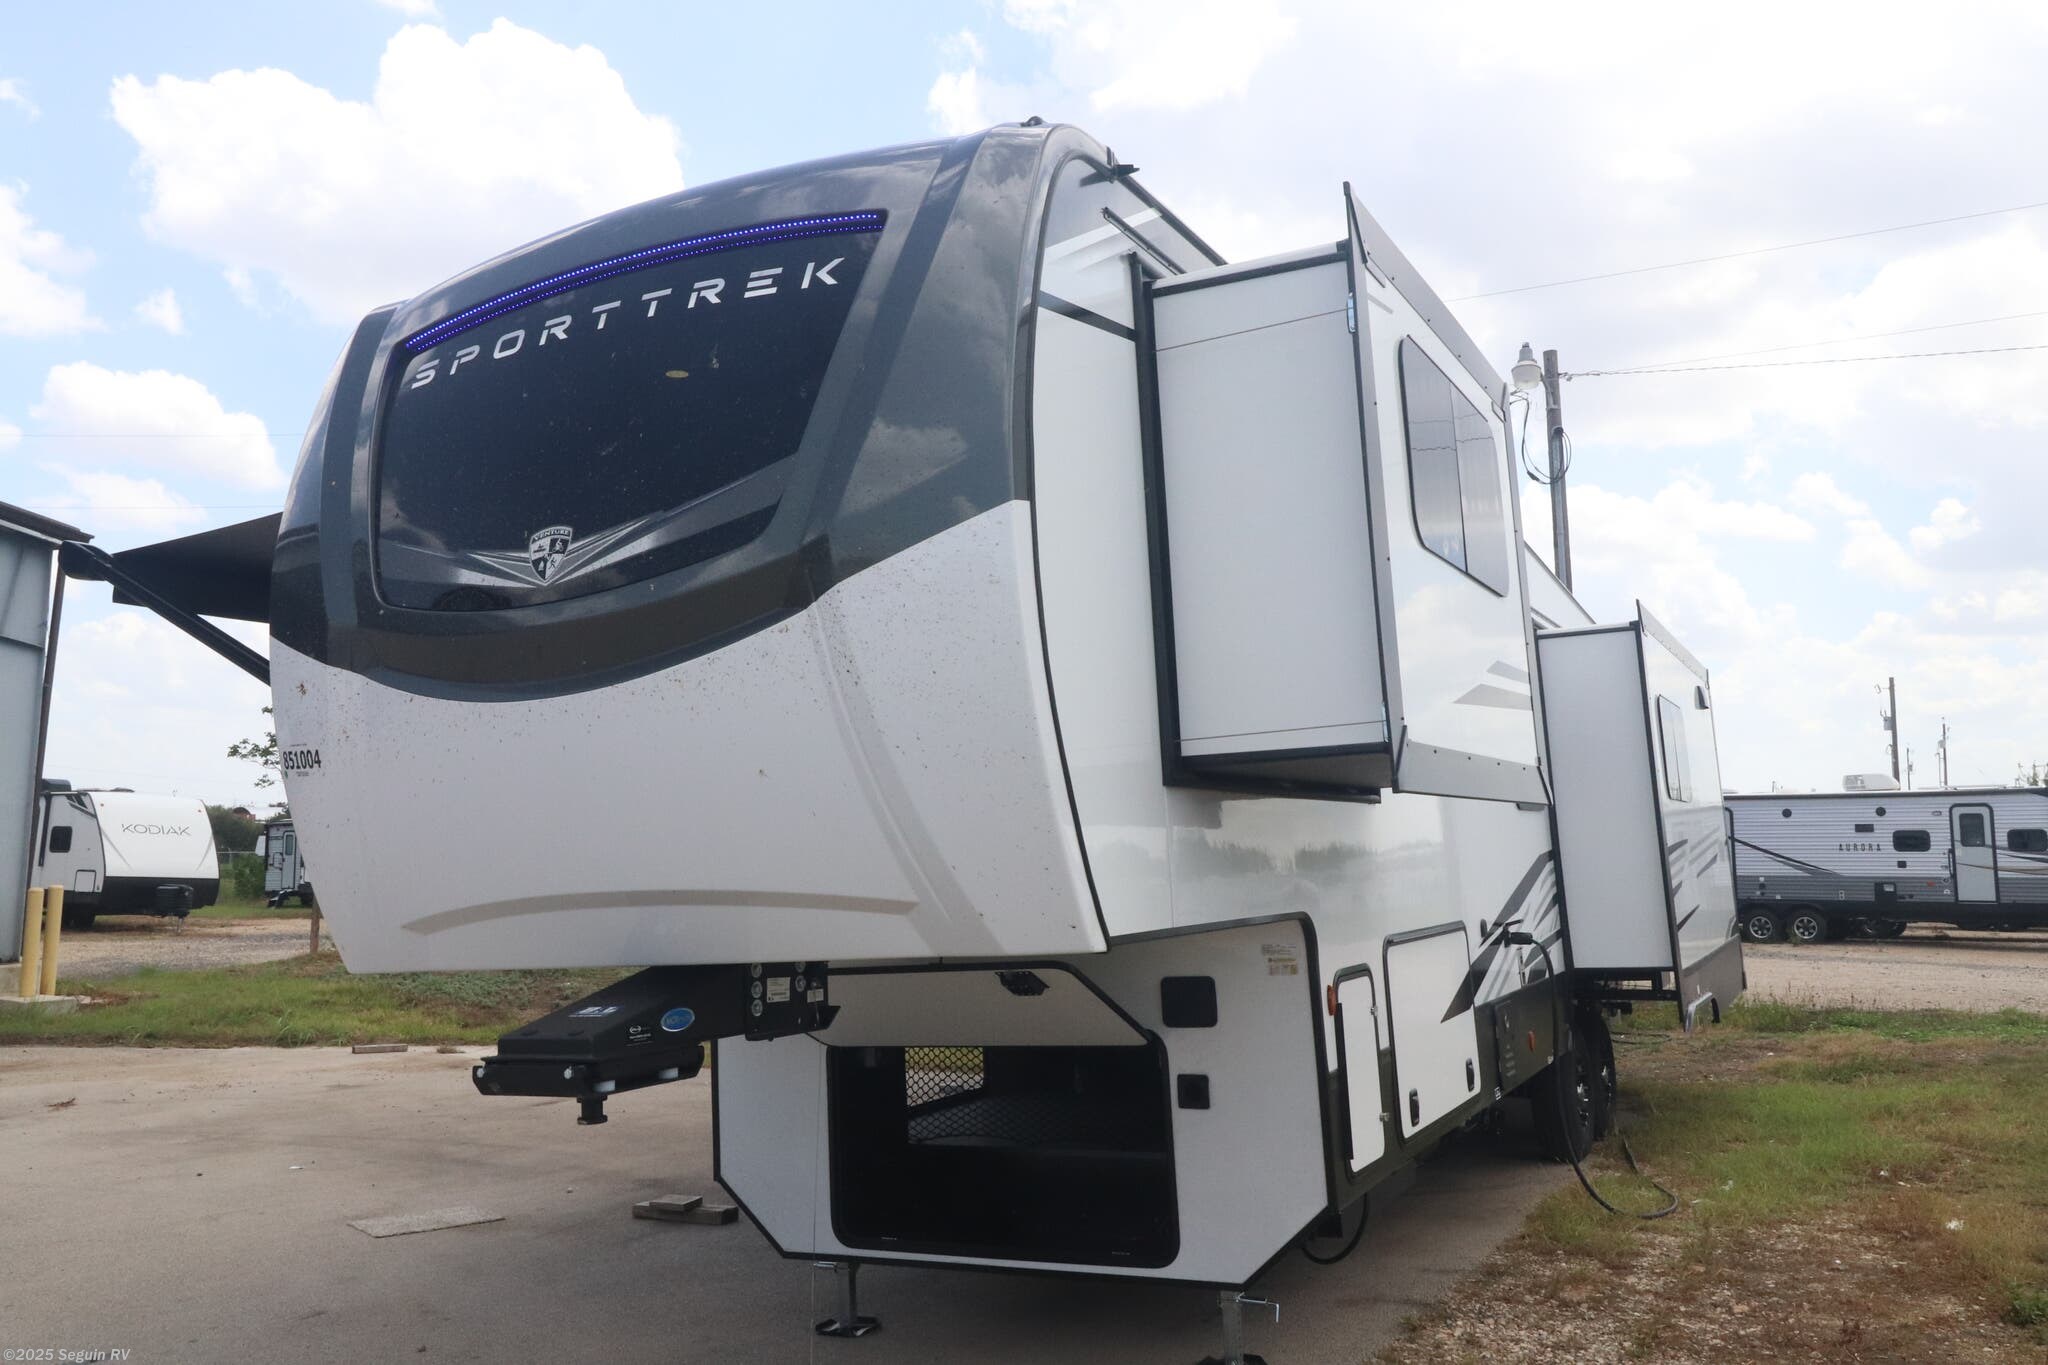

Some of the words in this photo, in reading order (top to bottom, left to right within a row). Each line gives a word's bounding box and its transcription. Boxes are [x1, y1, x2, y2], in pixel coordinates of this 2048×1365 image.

[411, 257, 845, 389] SPORTTREK
[533, 529, 570, 541] VENTURE
[282, 749, 322, 770] 851004
[121, 823, 192, 836] KODIAK
[1838, 842, 1882, 852] AURORA
